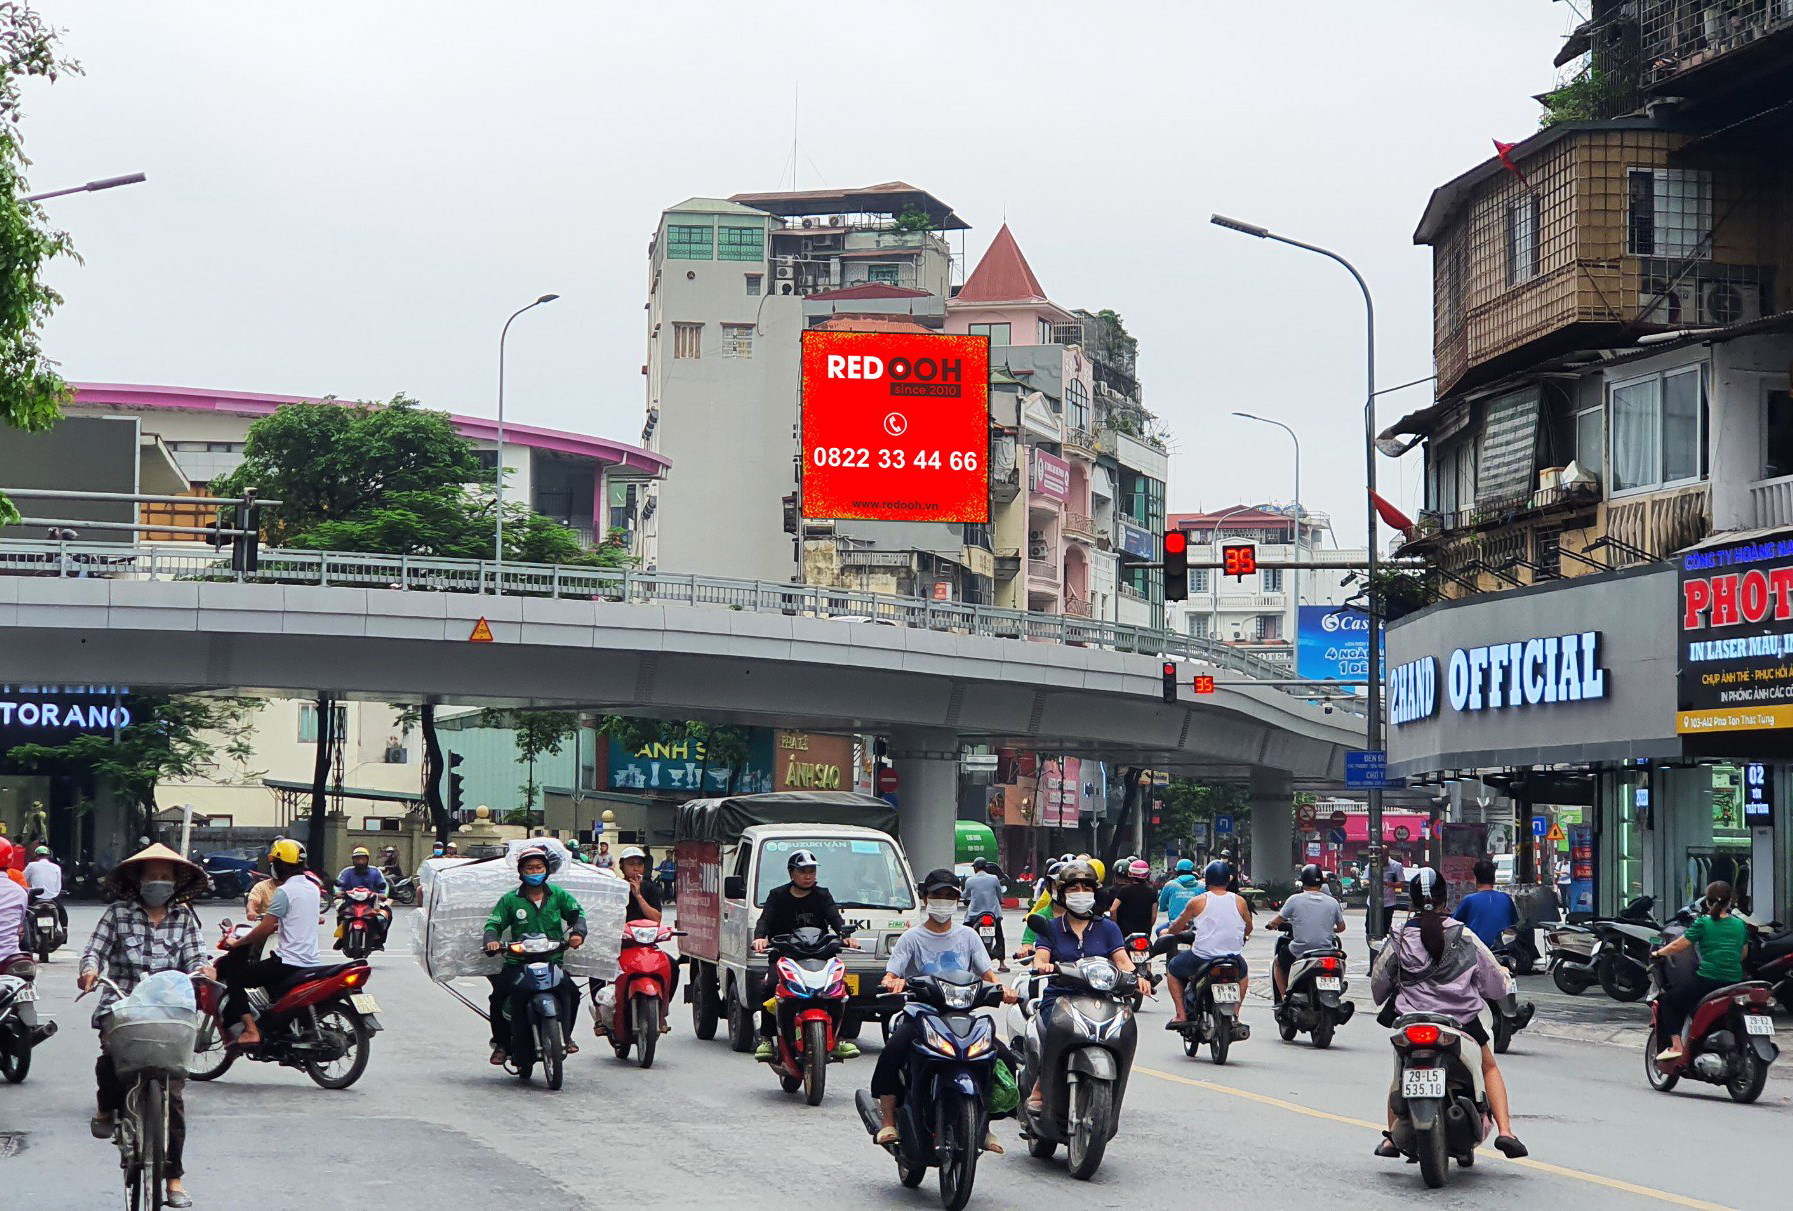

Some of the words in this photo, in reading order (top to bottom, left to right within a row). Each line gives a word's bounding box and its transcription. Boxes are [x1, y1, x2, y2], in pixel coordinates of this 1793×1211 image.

[827, 354, 884, 380] RED
[888, 356, 962, 382] OOH
[894, 385, 926, 395] since
[929, 385, 957, 396] 2010
[813, 447, 870, 468] 0822
[878, 449, 906, 469] 33
[913, 450, 942, 470] 44
[949, 451, 978, 471] 66
[852, 499, 939, 511] www.redooh.vn
[1685, 551, 1715, 571] CÔNG
[1718, 549, 1732, 567] TY
[1735, 541, 1775, 564] HOÀNG
[1252, 652, 1291, 661] OTEL
[1325, 647, 1338, 660] 4
[1339, 646, 1369, 660] NGÀ
[1690, 642, 1704, 661] IN
[1706, 638, 1747, 660] LASER
[1338, 660, 1348, 675] 1
[1196, 678, 1212, 691] 35
[1390, 655, 1437, 725] 2HAND
[1448, 631, 1604, 711] OFFICIAL
[1720, 691, 1728, 702] IN
[1769, 685, 1785, 699] CÁC
[814, 763, 841, 789] SAO
[1749, 765, 1765, 784] 02
[1409, 1070, 1438, 1082] 29-L5
[1405, 1083, 1442, 1096] 535.18
